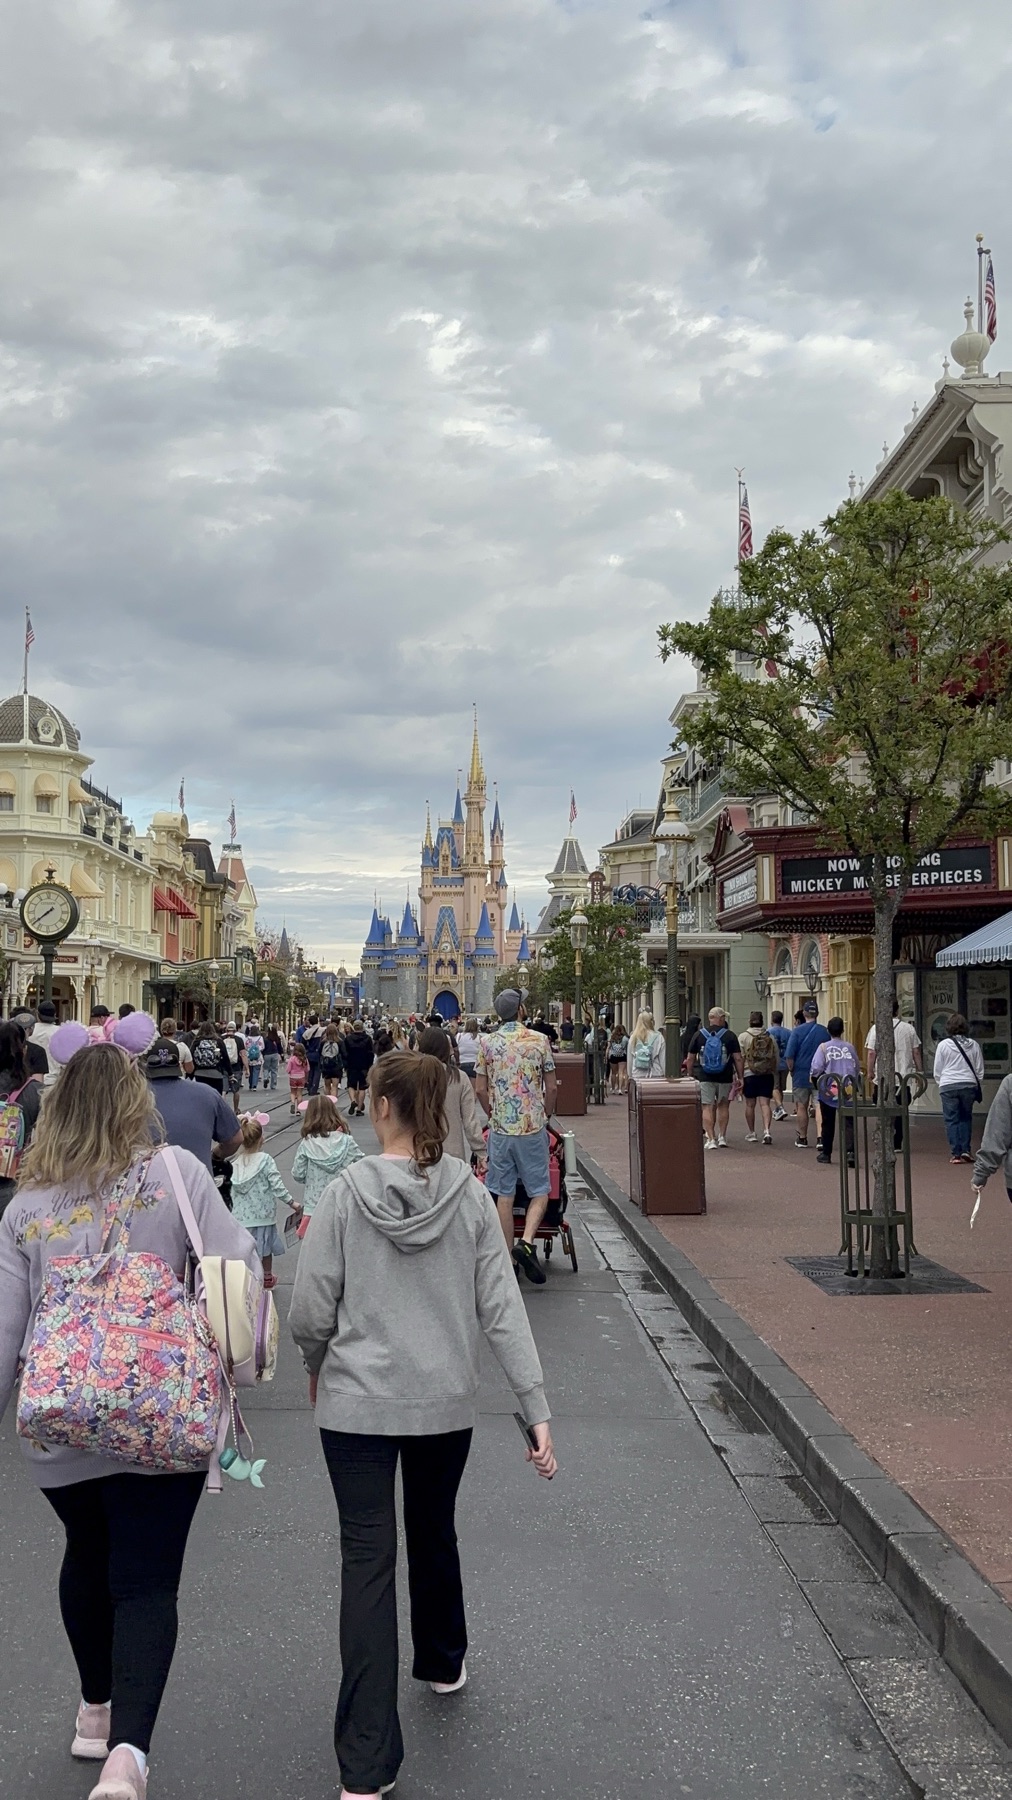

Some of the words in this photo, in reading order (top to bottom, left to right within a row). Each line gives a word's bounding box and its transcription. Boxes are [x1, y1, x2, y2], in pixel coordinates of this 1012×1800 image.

[827, 858, 861, 873] NOW
[790, 877, 843, 893] MICKEY
[46, 1190, 95, 1218] Your
